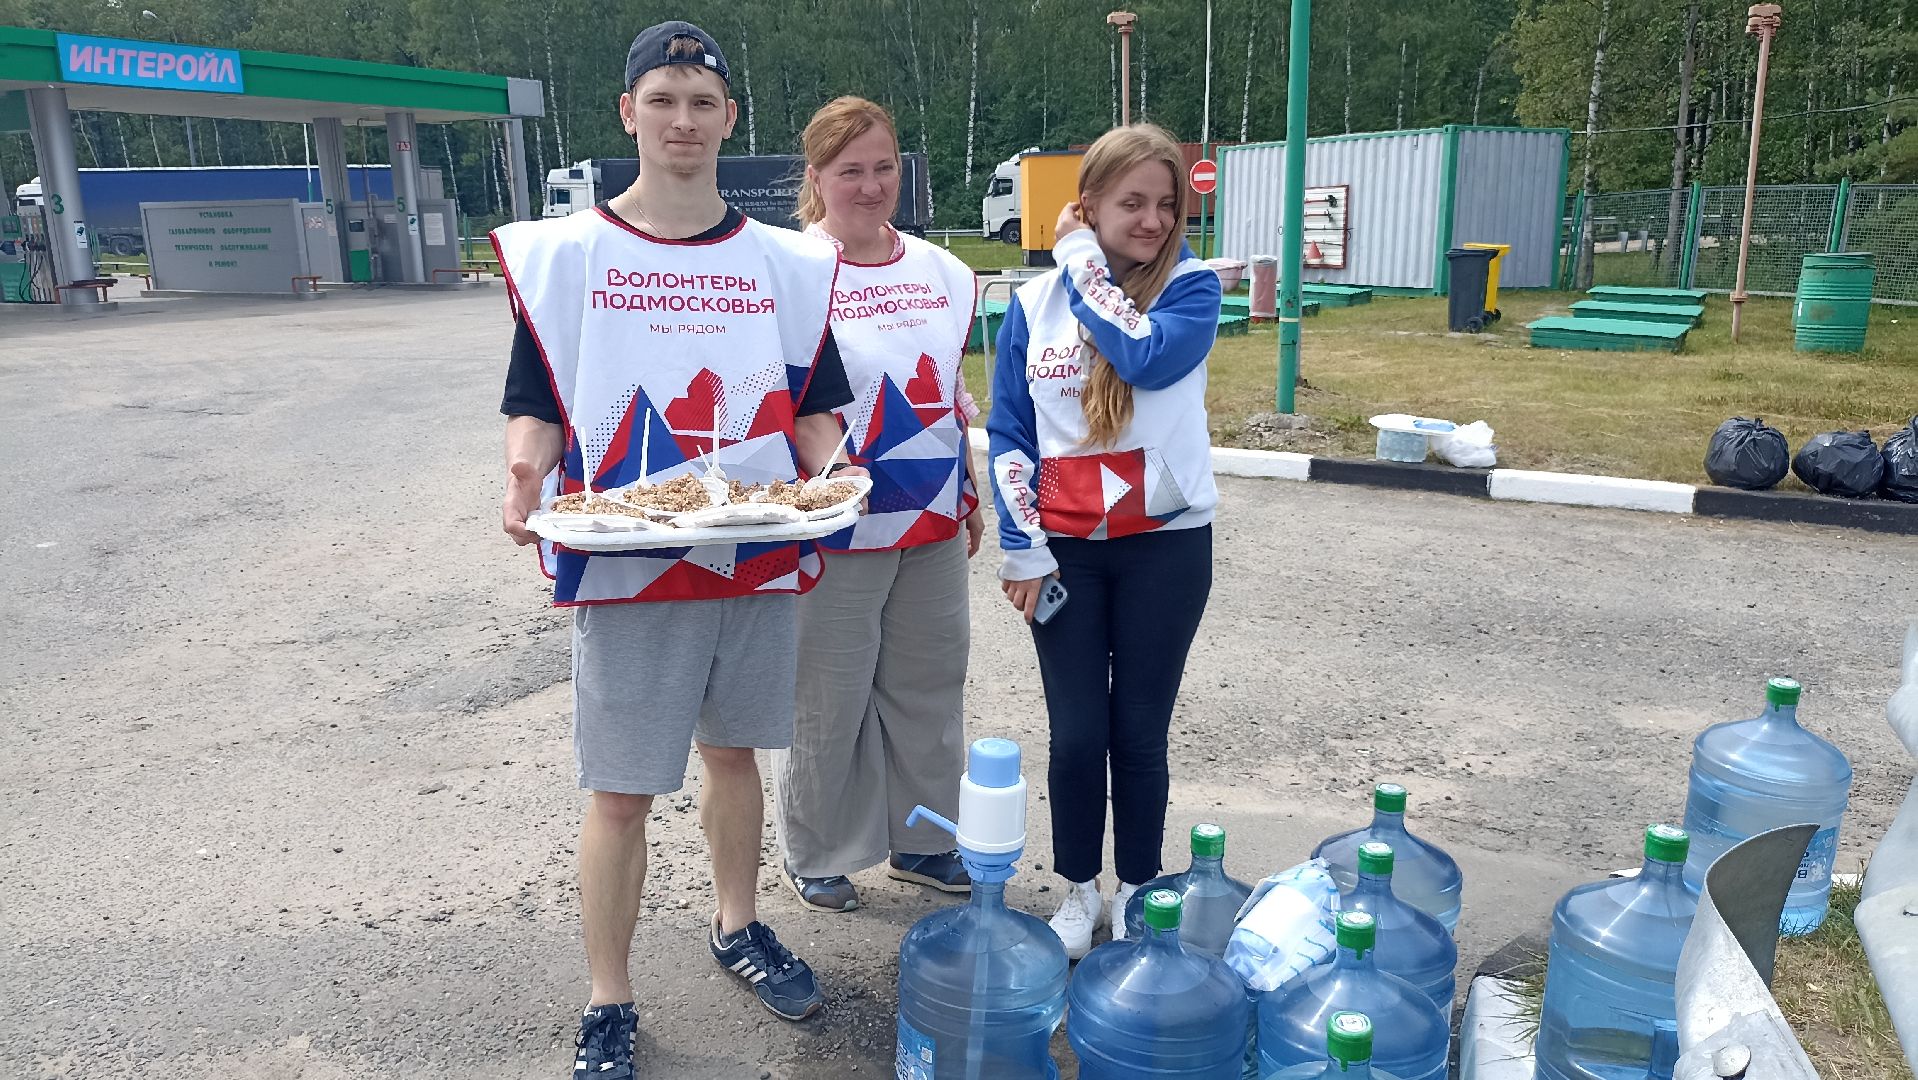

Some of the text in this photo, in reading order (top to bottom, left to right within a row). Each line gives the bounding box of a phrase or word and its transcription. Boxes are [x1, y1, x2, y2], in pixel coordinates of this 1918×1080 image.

[69, 44, 237, 84] ИНТЕРОЙЛ
[51, 193, 65, 215] 3
[198, 211, 234, 219] УСТАНОВКА
[325, 198, 334, 215] 5
[396, 196, 406, 213] 5
[607, 268, 757, 292] ВОЛОНТЕРЫ
[592, 290, 776, 315] ПОДМОСКОВЬЯ
[834, 283, 932, 305] ВОЛОНТЕРЫ
[831, 296, 949, 322] ПОДМОСКОВЬЯ
[649, 323, 726, 335] МЫ РЯДОМ
